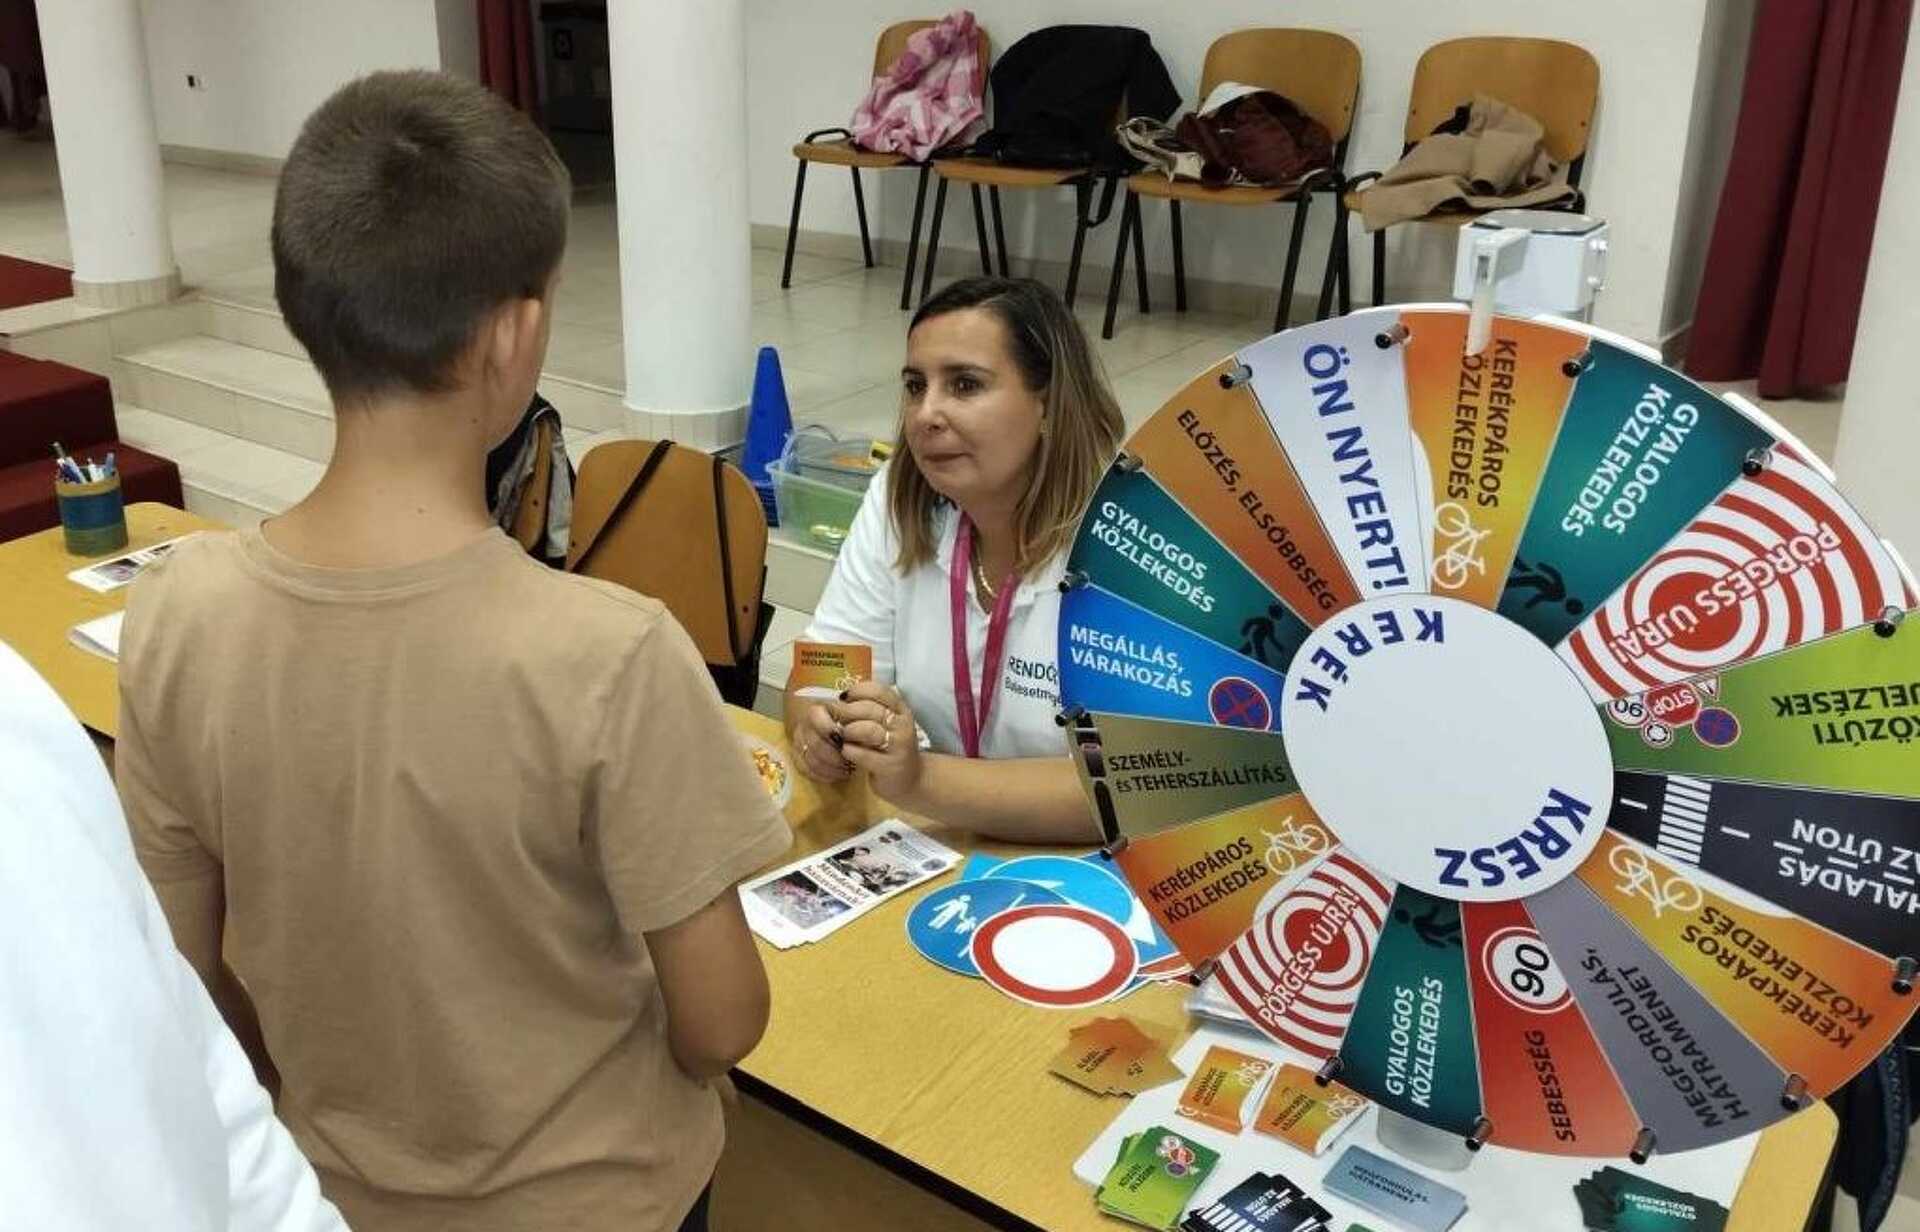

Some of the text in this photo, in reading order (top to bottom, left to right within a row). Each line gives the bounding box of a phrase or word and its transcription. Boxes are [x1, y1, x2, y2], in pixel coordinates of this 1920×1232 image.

[1303, 343, 1409, 589] ÖN NYERT!
[1447, 350, 1489, 500] ÖZLEKEDÉS
[1477, 338, 1518, 508] KERÉKPÁROS
[1561, 383, 1673, 538] KÖZLEKEDÉS
[1602, 402, 1699, 536] GYALOGOS
[1101, 501, 1208, 580] GYALOGOS
[1177, 409, 1339, 612] ELŐZÉS, ELSŐBBSÉG
[1091, 523, 1216, 613] KÖZLEKEDÉS
[1609, 521, 1842, 664] PÖRGESS ÚJRA!
[1070, 623, 1184, 674] MEGÁLLÁS,
[1070, 648, 1193, 698] VÁRAKOZÁS
[1296, 608, 1444, 712] KERÉK
[1653, 689, 1695, 716] STOP
[1108, 750, 1192, 772] SZEMÉLY-
[1615, 699, 1643, 719] 90
[1134, 764, 1287, 792] TEHERSZÁLLÍTÁS
[1148, 836, 1254, 903] KERÉKPÁROS
[1163, 858, 1269, 925] KÖZLEKEDÉS
[1434, 788, 1592, 888] KRESZ
[1791, 819, 1882, 864] ÚTON
[1257, 939, 1324, 1028] PÖRGESS
[1311, 885, 1361, 946] ÚJRA!
[1511, 943, 1550, 998] 90
[1681, 924, 1857, 1050] KERÉKPÁROS
[1699, 905, 1877, 1031] KÖZLEKEDÉS
[1385, 986, 1415, 1097] GYALOGOS
[1410, 976, 1444, 1108] KÖZLEKEDÉS
[1524, 1029, 1576, 1143] SEBESSÉG
[1580, 947, 1723, 1128] MEGFORDULÁS,
[1617, 965, 1751, 1122] HÁTRAMENET
